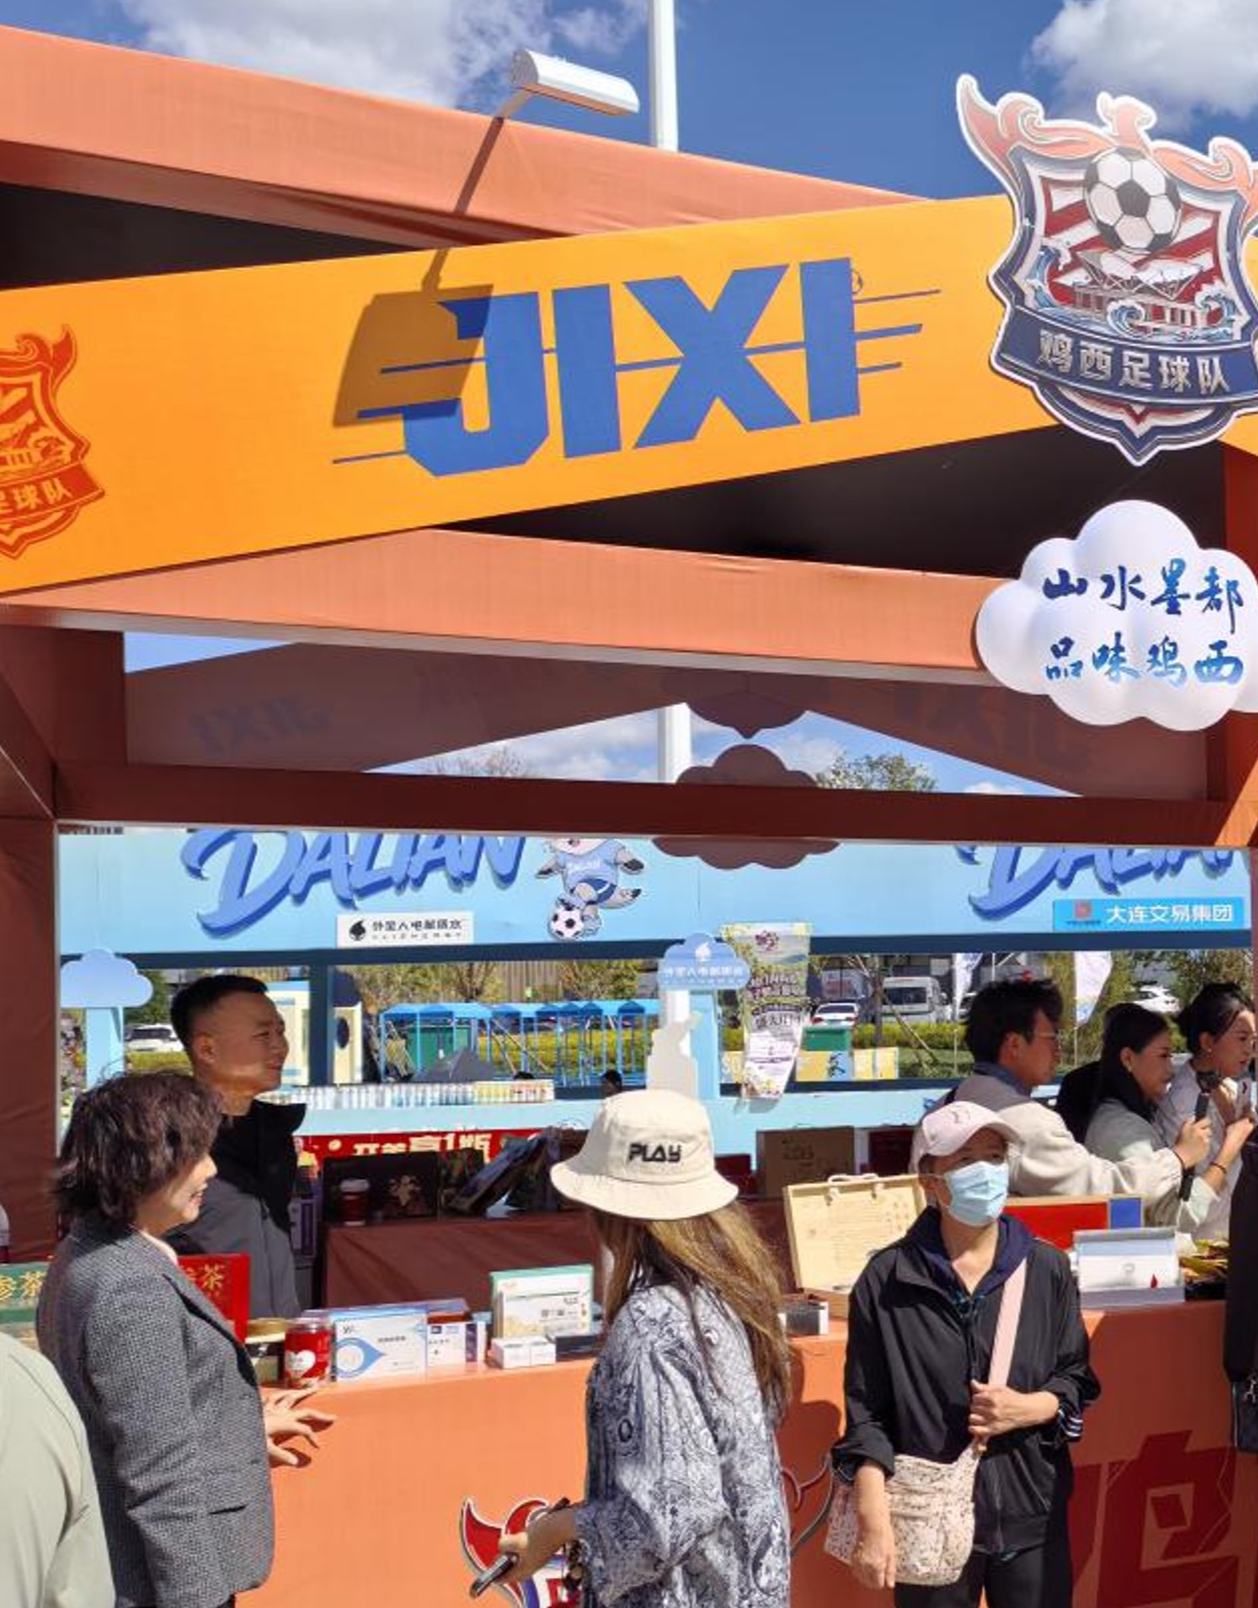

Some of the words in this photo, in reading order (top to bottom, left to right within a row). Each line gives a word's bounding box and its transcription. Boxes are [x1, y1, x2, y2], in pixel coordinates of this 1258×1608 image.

[401, 257, 861, 478] JIXI
[1036, 329, 1231, 394] 鸡西足球队
[1045, 631, 1244, 687] 品味鸡西
[1106, 903, 1233, 925] 大连交易集团
[628, 1142, 683, 1164] PLAY
